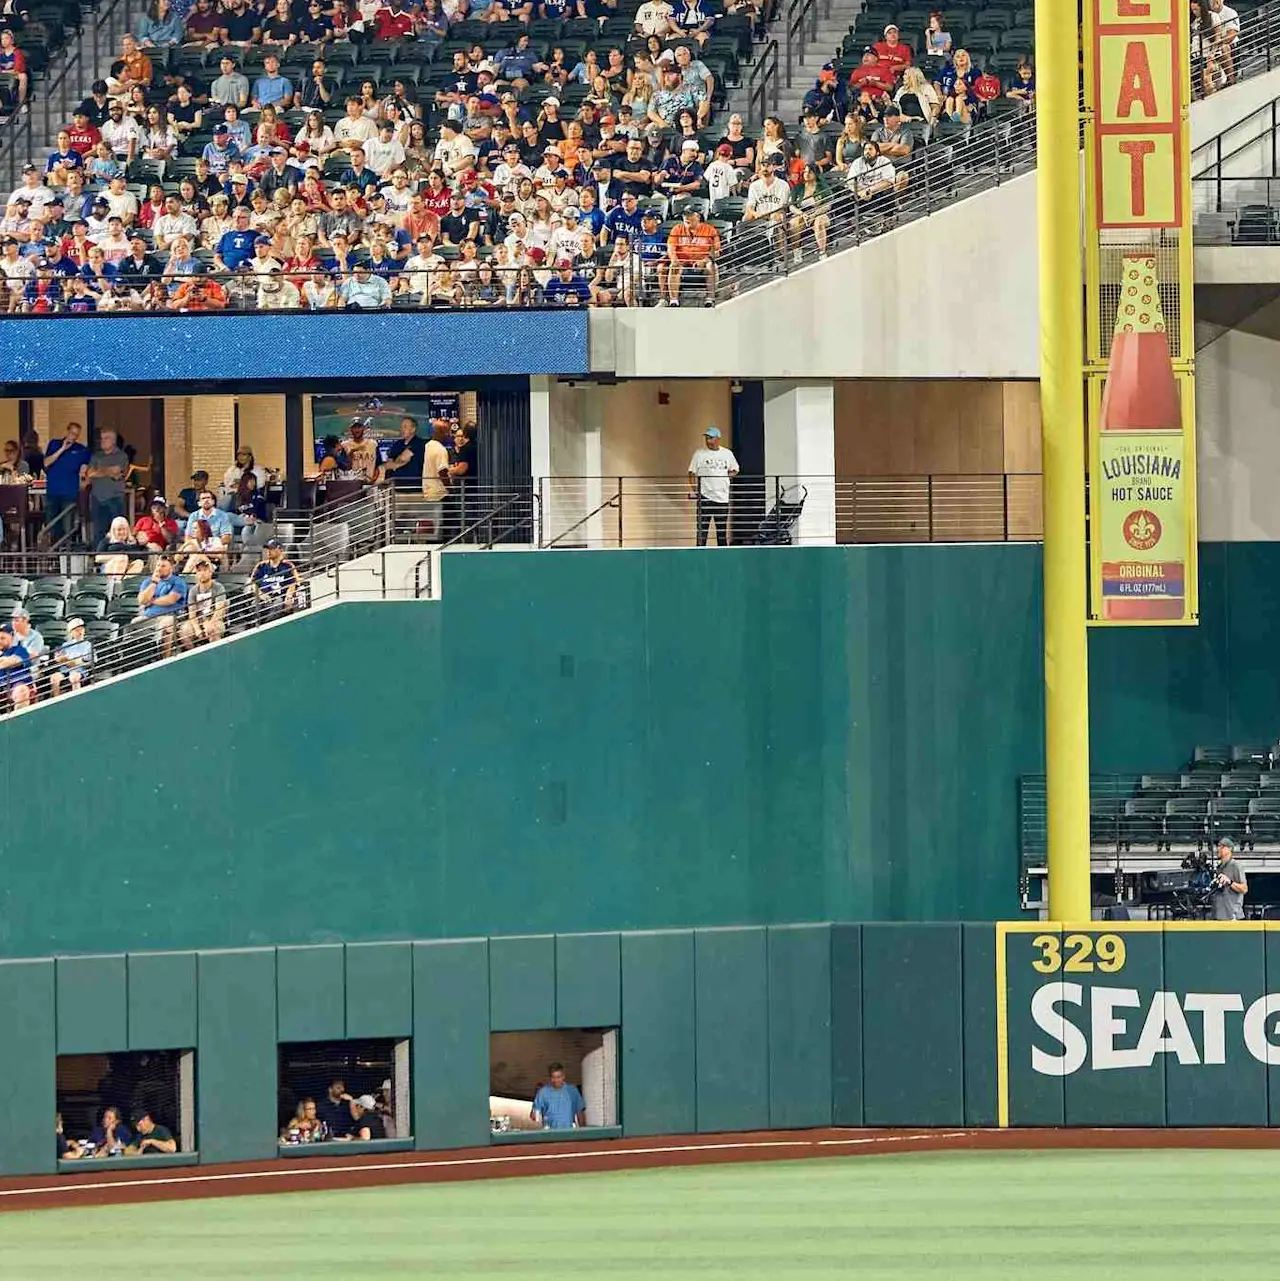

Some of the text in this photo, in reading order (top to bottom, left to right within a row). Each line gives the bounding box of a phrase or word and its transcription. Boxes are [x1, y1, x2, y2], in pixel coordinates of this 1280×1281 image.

[544, 0, 566, 7] TEXAS
[980, 84, 996, 94] TEXAS
[70, 136, 92, 144] TEXAS
[424, 198, 450, 208] TEXAS
[755, 196, 780, 207] ASTROS
[615, 222, 642, 234] TEXAS
[234, 238, 244, 248] T
[634, 242, 661, 253] TEXAS
[1102, 455, 1181, 480] LOUISIANA
[1132, 477, 1152, 485] BRAND
[1112, 487, 1173, 501] HOT SAUCE
[1119, 565, 1165, 578] ORIGINAL
[1032, 934, 1127, 974] 329
